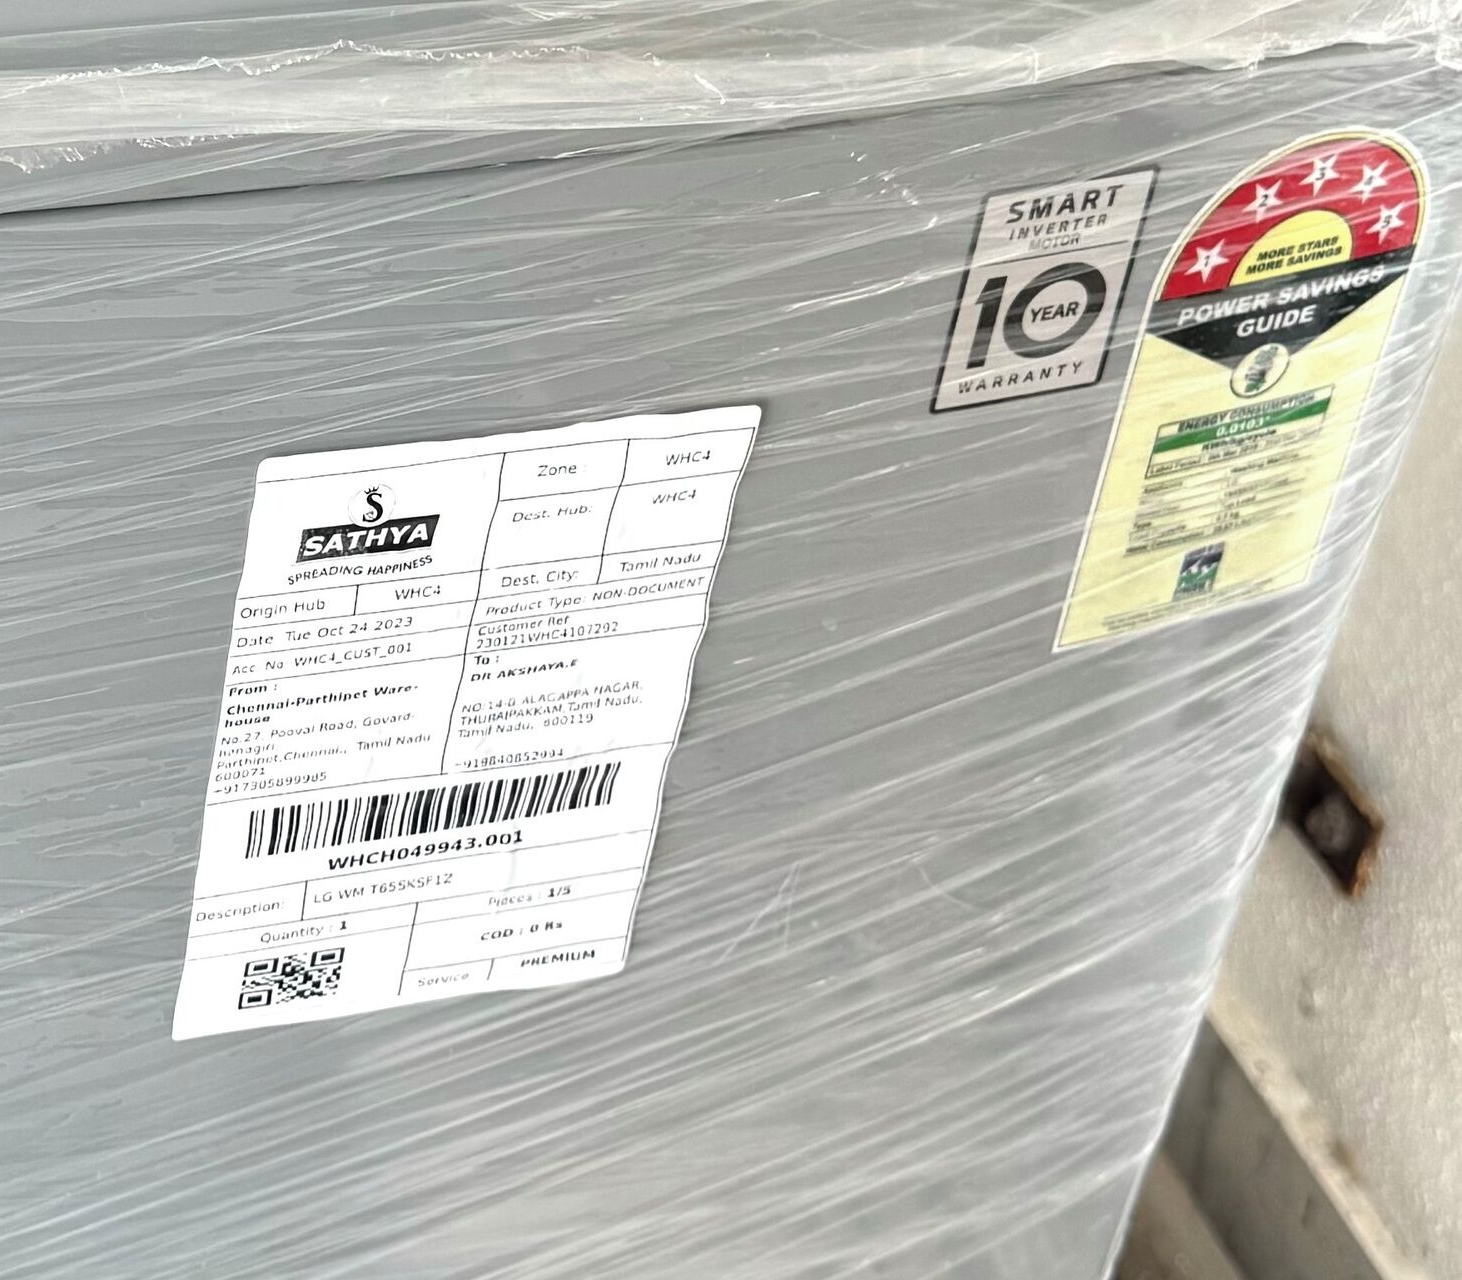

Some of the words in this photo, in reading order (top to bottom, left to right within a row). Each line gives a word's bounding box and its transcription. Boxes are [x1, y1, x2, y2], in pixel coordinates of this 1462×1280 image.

[1006, 183, 1125, 224] SMART
[1258, 193, 1269, 207] 2
[1008, 213, 1108, 241] INVERTER
[1257, 244, 1296, 261] MORE
[1296, 234, 1340, 254] STARS
[1245, 259, 1285, 276] MORE
[1286, 246, 1343, 267] SAVINGS
[1178, 291, 1270, 327] POWER
[1274, 264, 1387, 303] SAVINGS
[966, 260, 1108, 370] 10
[1030, 300, 1081, 324] YEAR
[1236, 304, 1318, 338] GUIDE
[958, 360, 1085, 395] WARRANTY
[665, 449, 712, 466] WHC4
[536, 464, 577, 478] Zone
[652, 488, 698, 505] WHC4
[302, 522, 430, 558] SATHYA
[287, 564, 364, 586] SPREADING
[366, 554, 434, 577] HAPPINESS
[619, 556, 658, 573] Tamil
[662, 552, 702, 566] Nadu
[500, 574, 540, 589] Dest.
[393, 584, 442, 602] WHC4
[485, 599, 543, 617] Product
[592, 575, 706, 602] NON-DOCUMENT
[240, 603, 288, 620] Origin
[285, 630, 312, 643] Tue
[317, 625, 345, 639] Oct
[348, 621, 369, 635] 24
[373, 615, 415, 632] 2023
[477, 619, 544, 637] Customer
[473, 655, 491, 666] To
[228, 683, 269, 698] From
[224, 715, 271, 729] house
[356, 736, 392, 752] Tamil
[396, 732, 431, 746] Nadu
[327, 829, 524, 871] WHCH049943.001
[313, 891, 333, 904] LG
[338, 886, 365, 900] WM
[547, 885, 572, 899] 1/5
[259, 923, 326, 945] Quantity
[339, 920, 348, 931] 1
[480, 927, 515, 942] COD
[520, 949, 596, 969] PREMIUM
